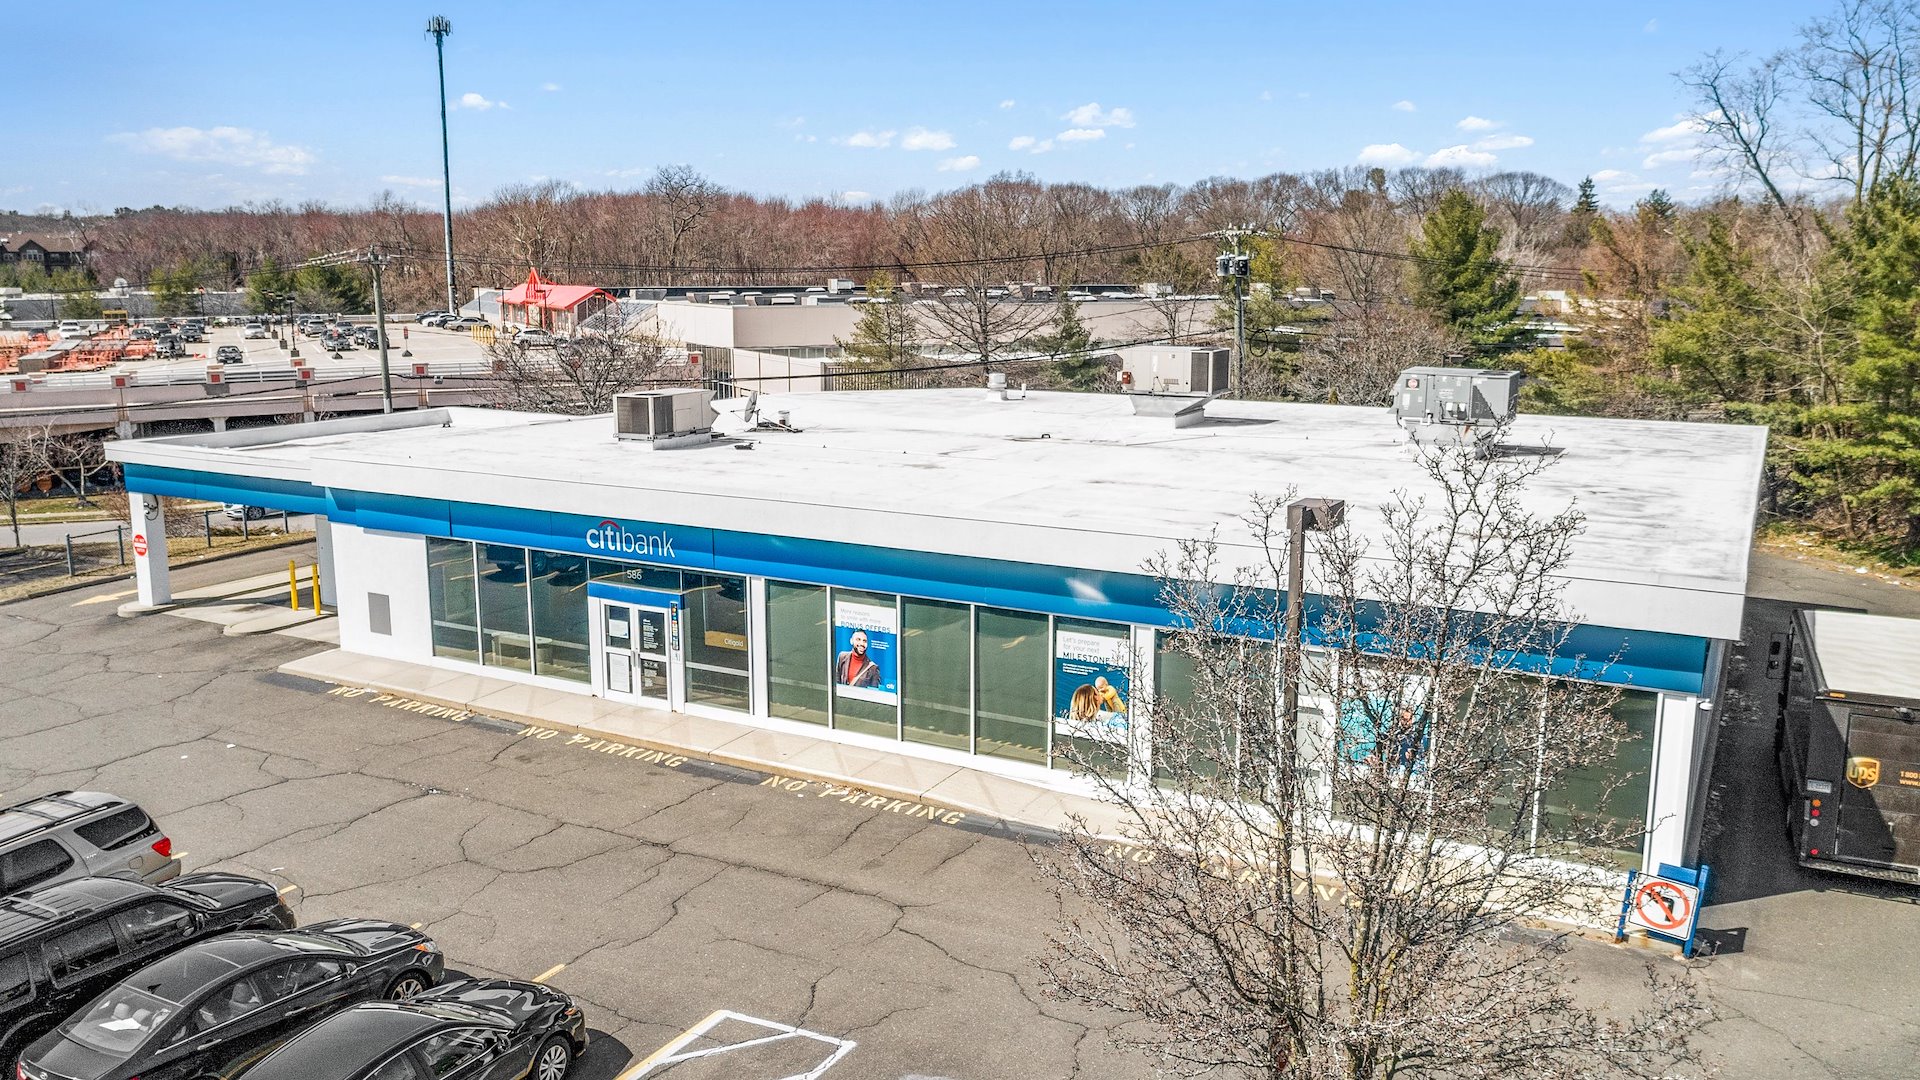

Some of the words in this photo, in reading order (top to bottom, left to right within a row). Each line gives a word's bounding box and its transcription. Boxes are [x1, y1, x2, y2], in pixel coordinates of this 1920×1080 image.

[586, 520, 675, 558] citibank
[626, 570, 642, 580] 586
[840, 621, 863, 629] BONUS
[865, 624, 891, 633] OFFERS
[724, 638, 744, 647] Citigold
[327, 686, 366, 698] NO
[368, 695, 471, 722] PARKING
[517, 726, 559, 740] NO
[565, 733, 688, 767] PARKING
[1849, 766, 1876, 783] ups
[760, 775, 808, 791] NO
[818, 787, 965, 825] PARKING
[1107, 842, 1156, 863] NO
